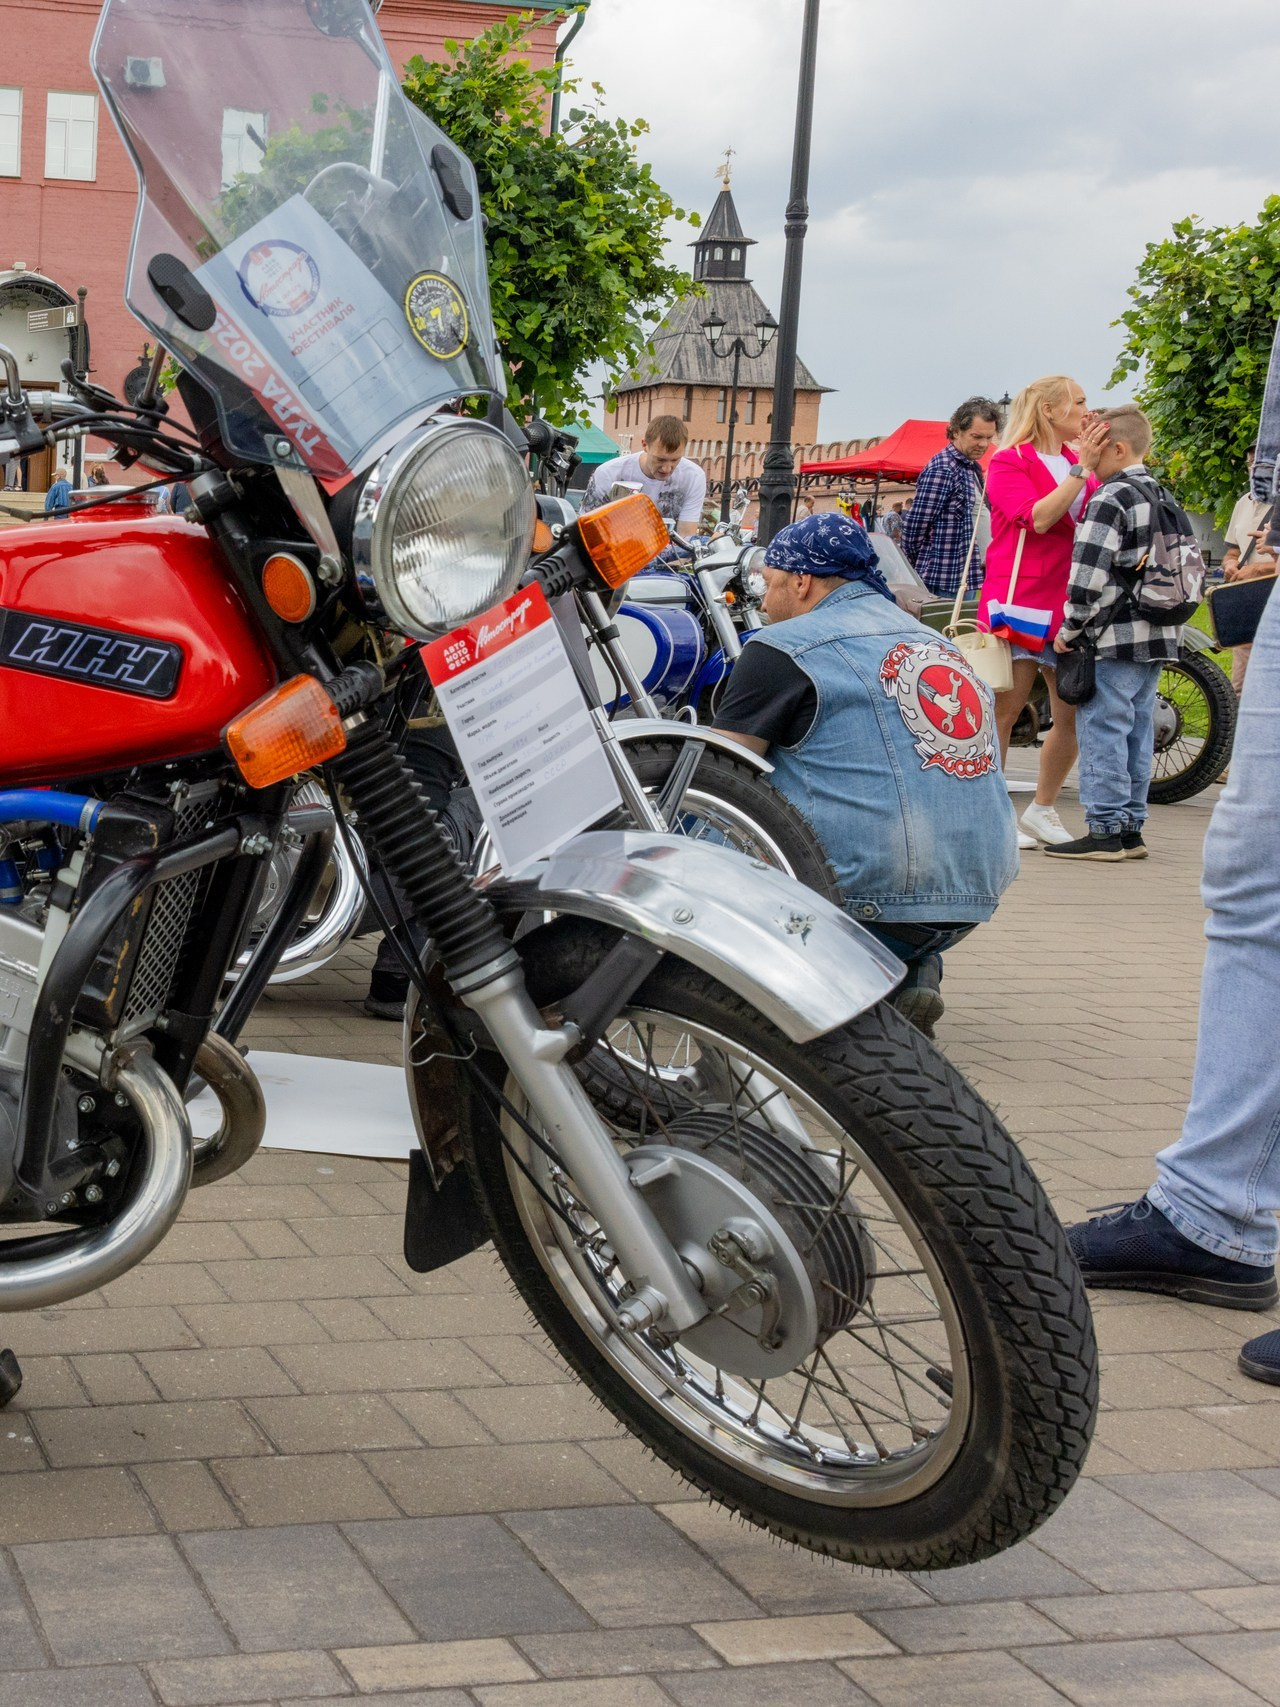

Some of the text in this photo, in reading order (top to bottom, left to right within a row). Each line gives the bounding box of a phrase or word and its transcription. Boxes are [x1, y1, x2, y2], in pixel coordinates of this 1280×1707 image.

[288, 297, 344, 343] УЧАСТНИК
[292, 304, 356, 356] ФЕСТИВАЛЯ
[261, 374, 322, 456] ТУЛА
[467, 597, 531, 658] Автострада
[443, 640, 466, 657] АВТО
[445, 647, 468, 664] МОТО
[448, 653, 470, 671] ФЕСТ
[449, 680, 471, 695] Категория
[461, 715, 475, 724] Город
[928, 752, 993, 776] РОССИЯ
